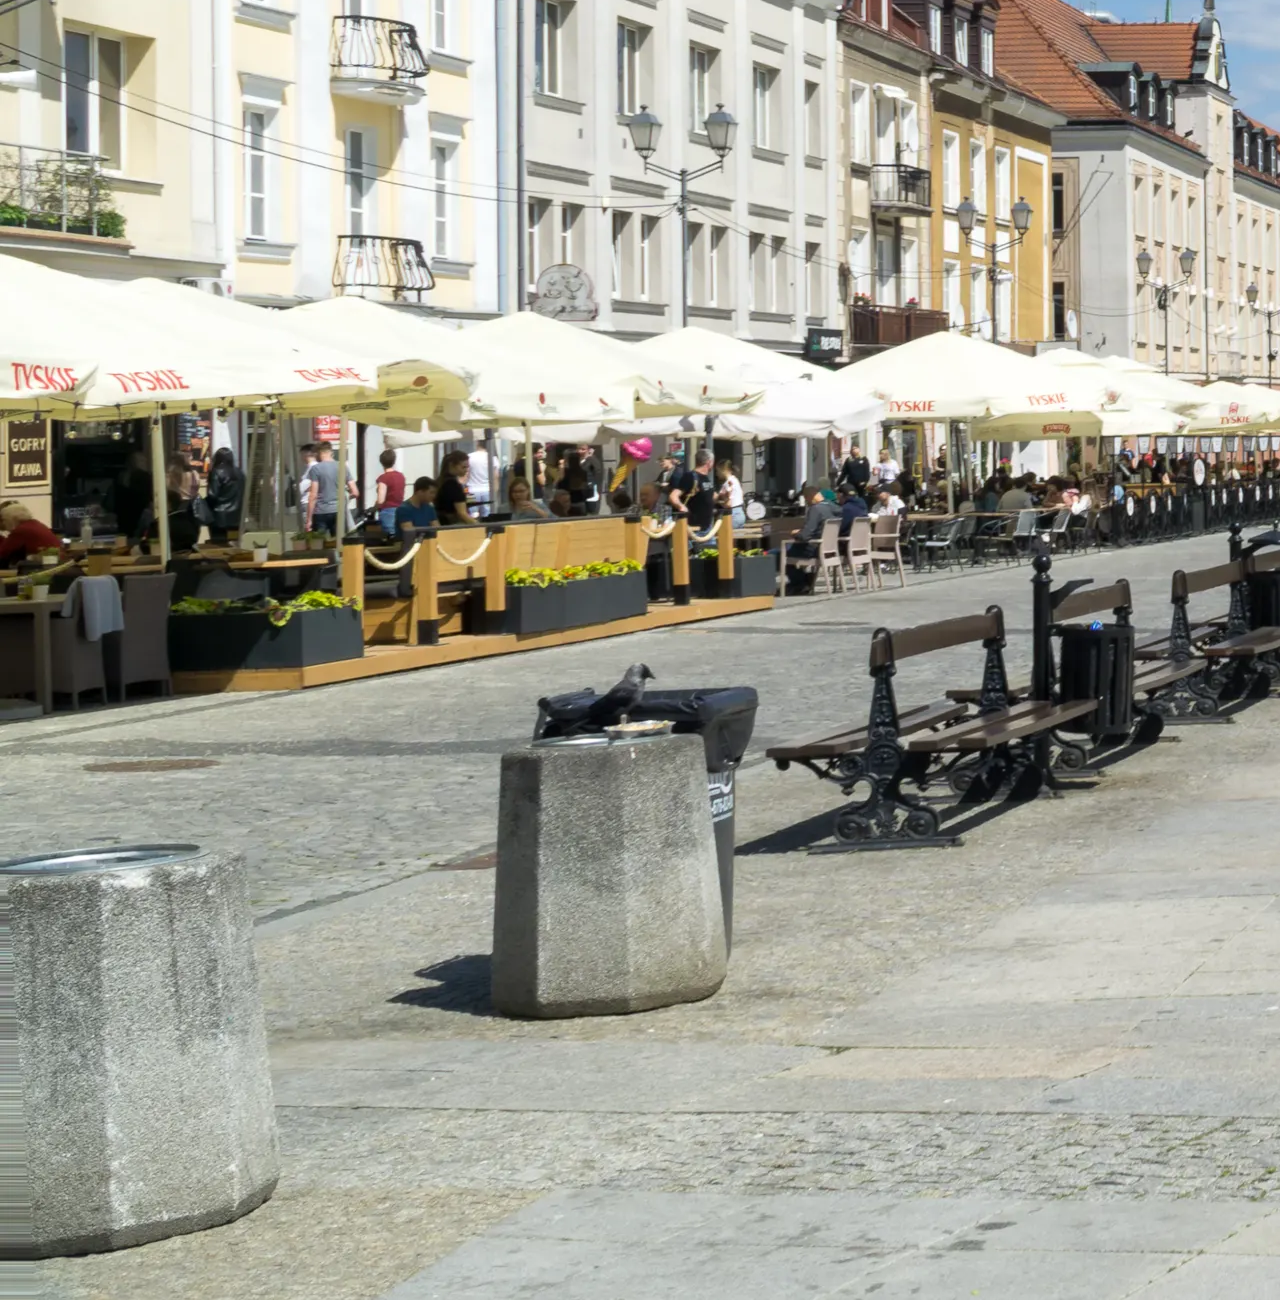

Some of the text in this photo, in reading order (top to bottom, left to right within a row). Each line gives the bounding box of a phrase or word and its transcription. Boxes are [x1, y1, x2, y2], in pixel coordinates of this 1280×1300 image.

[11, 362, 78, 392] TYSKIE
[108, 369, 190, 394] TYSKIE
[294, 367, 369, 383] TYSKIE
[1027, 392, 1068, 406] TYSKIE
[888, 401, 935, 413] TYSKIE
[1220, 416, 1250, 424] TYSKIE
[11, 437, 46, 452] GOFRY
[13, 463, 43, 477] KAWA
